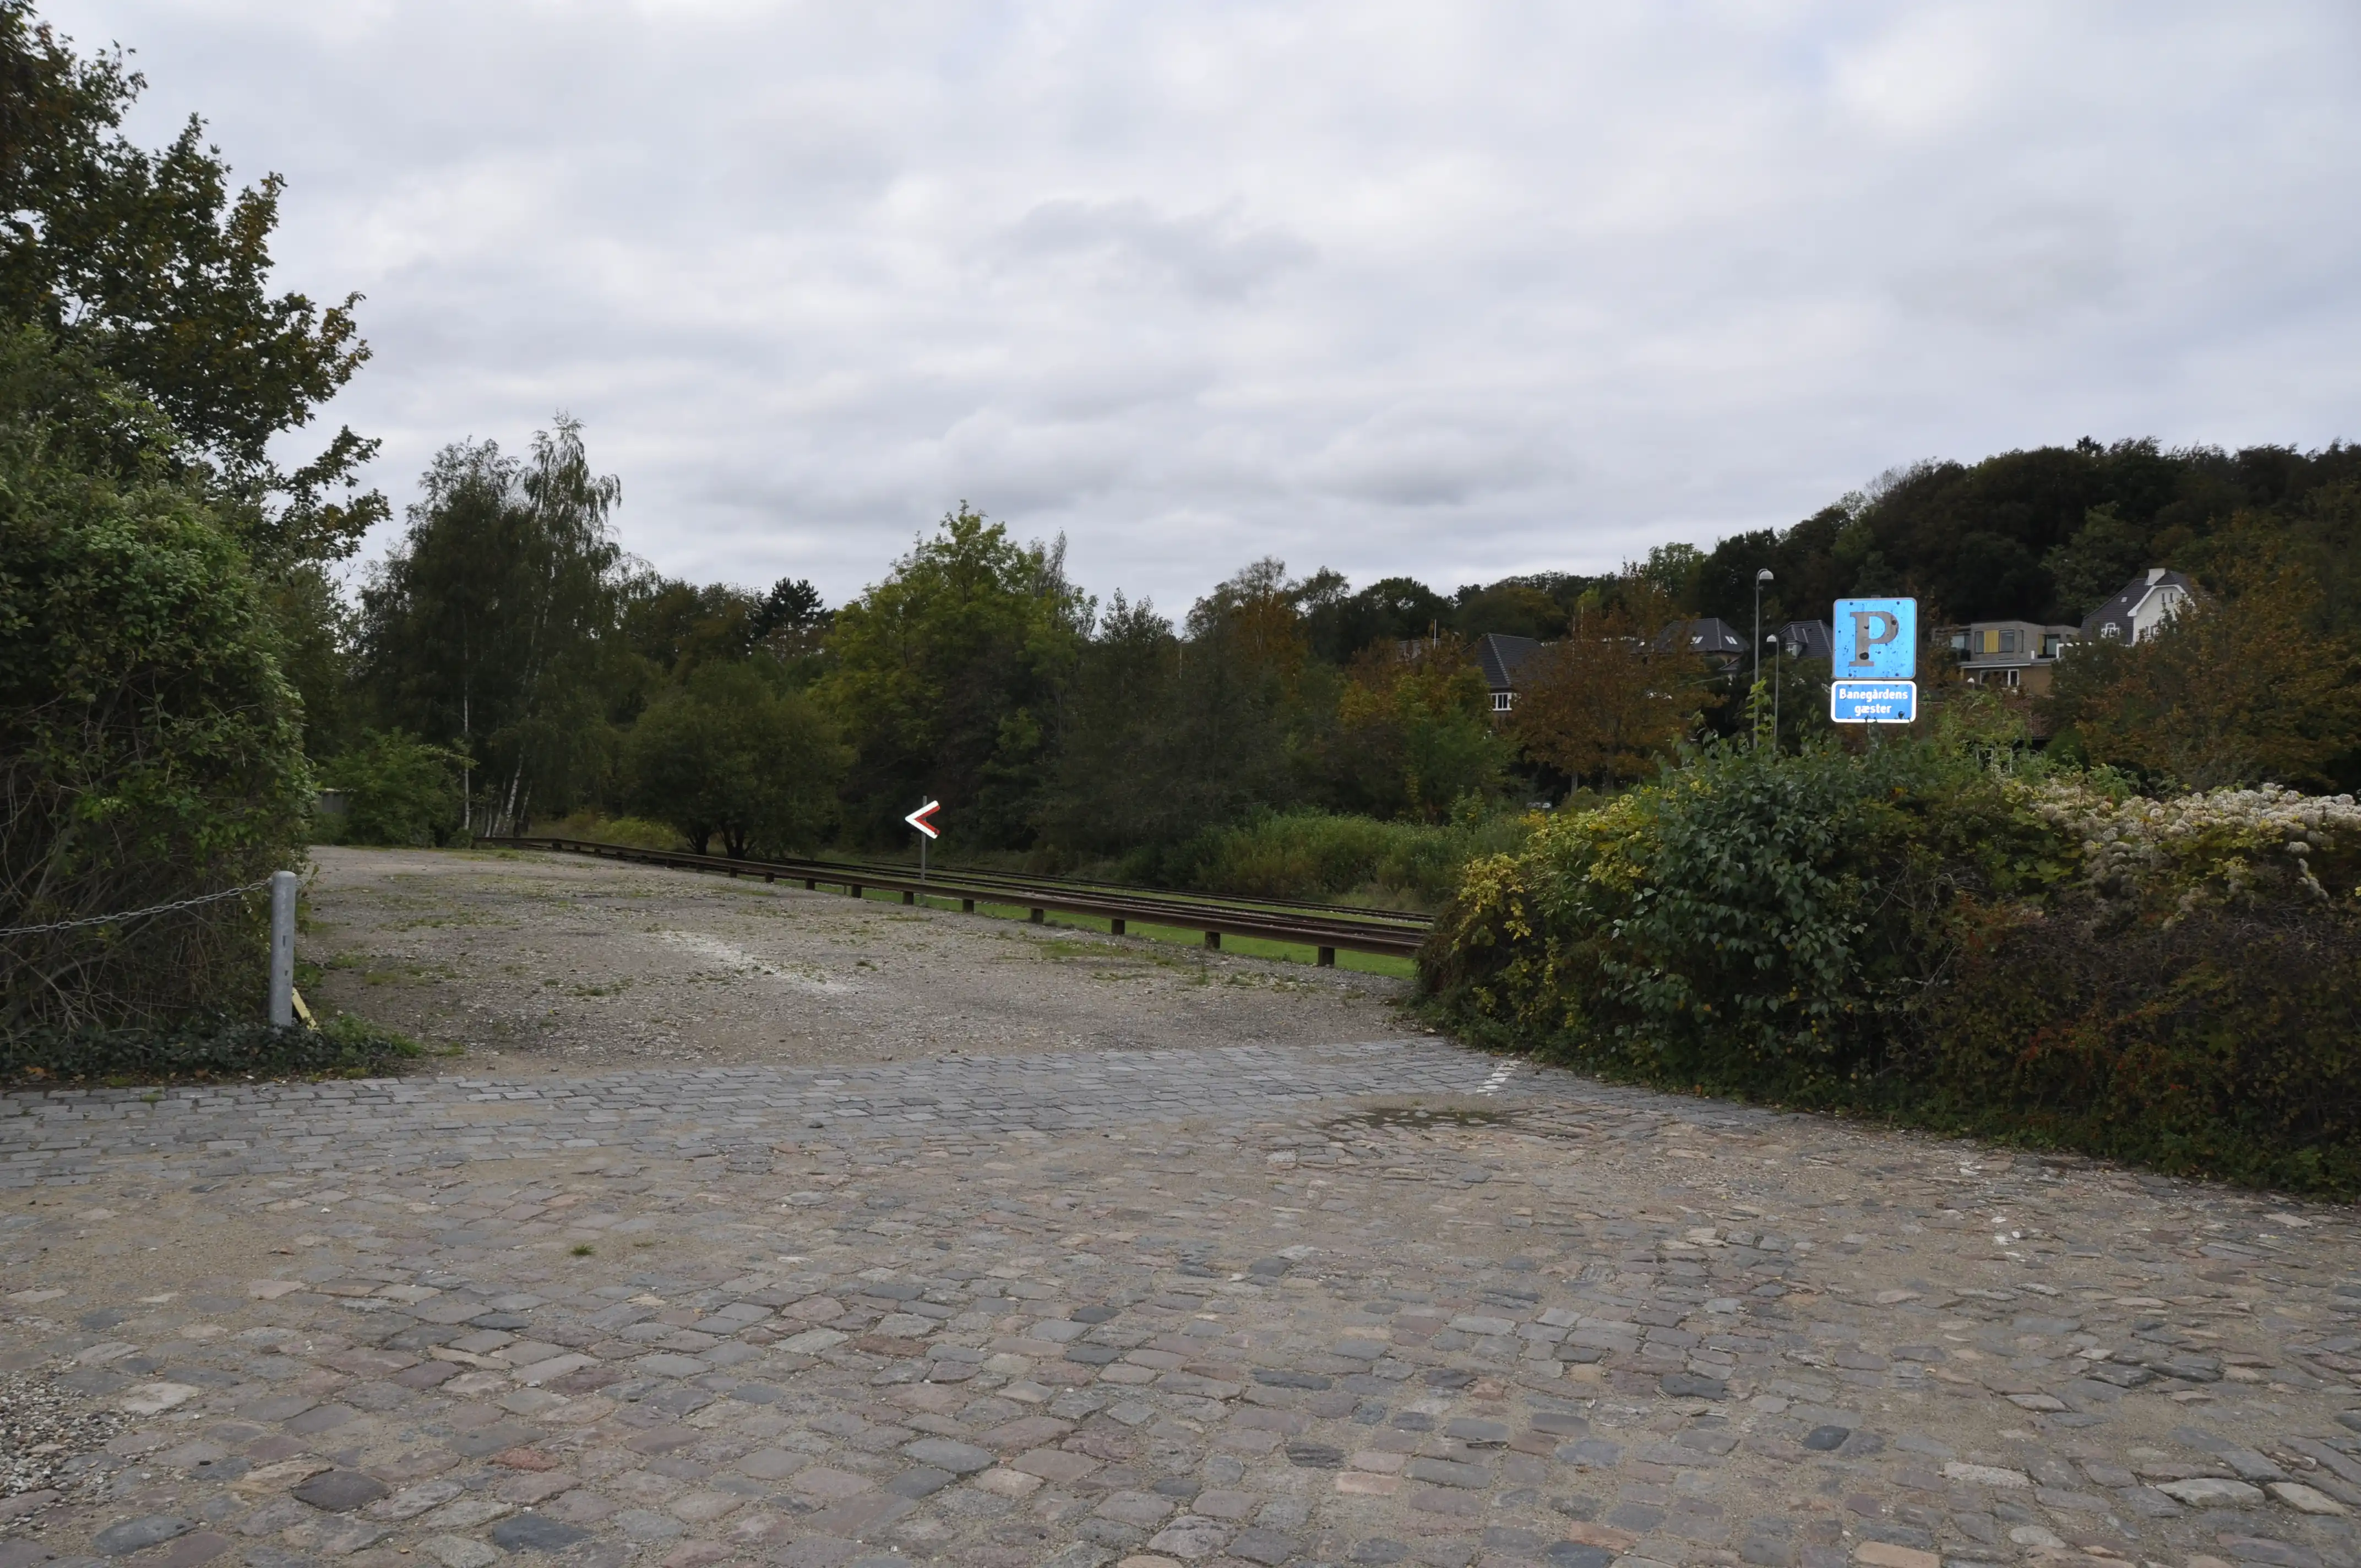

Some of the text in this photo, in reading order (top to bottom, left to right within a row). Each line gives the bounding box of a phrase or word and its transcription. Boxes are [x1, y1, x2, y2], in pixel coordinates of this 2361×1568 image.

[1849, 611, 1898, 666] P
[1839, 688, 1908, 702] Banegårdens
[1854, 704, 1892, 716] gæster
